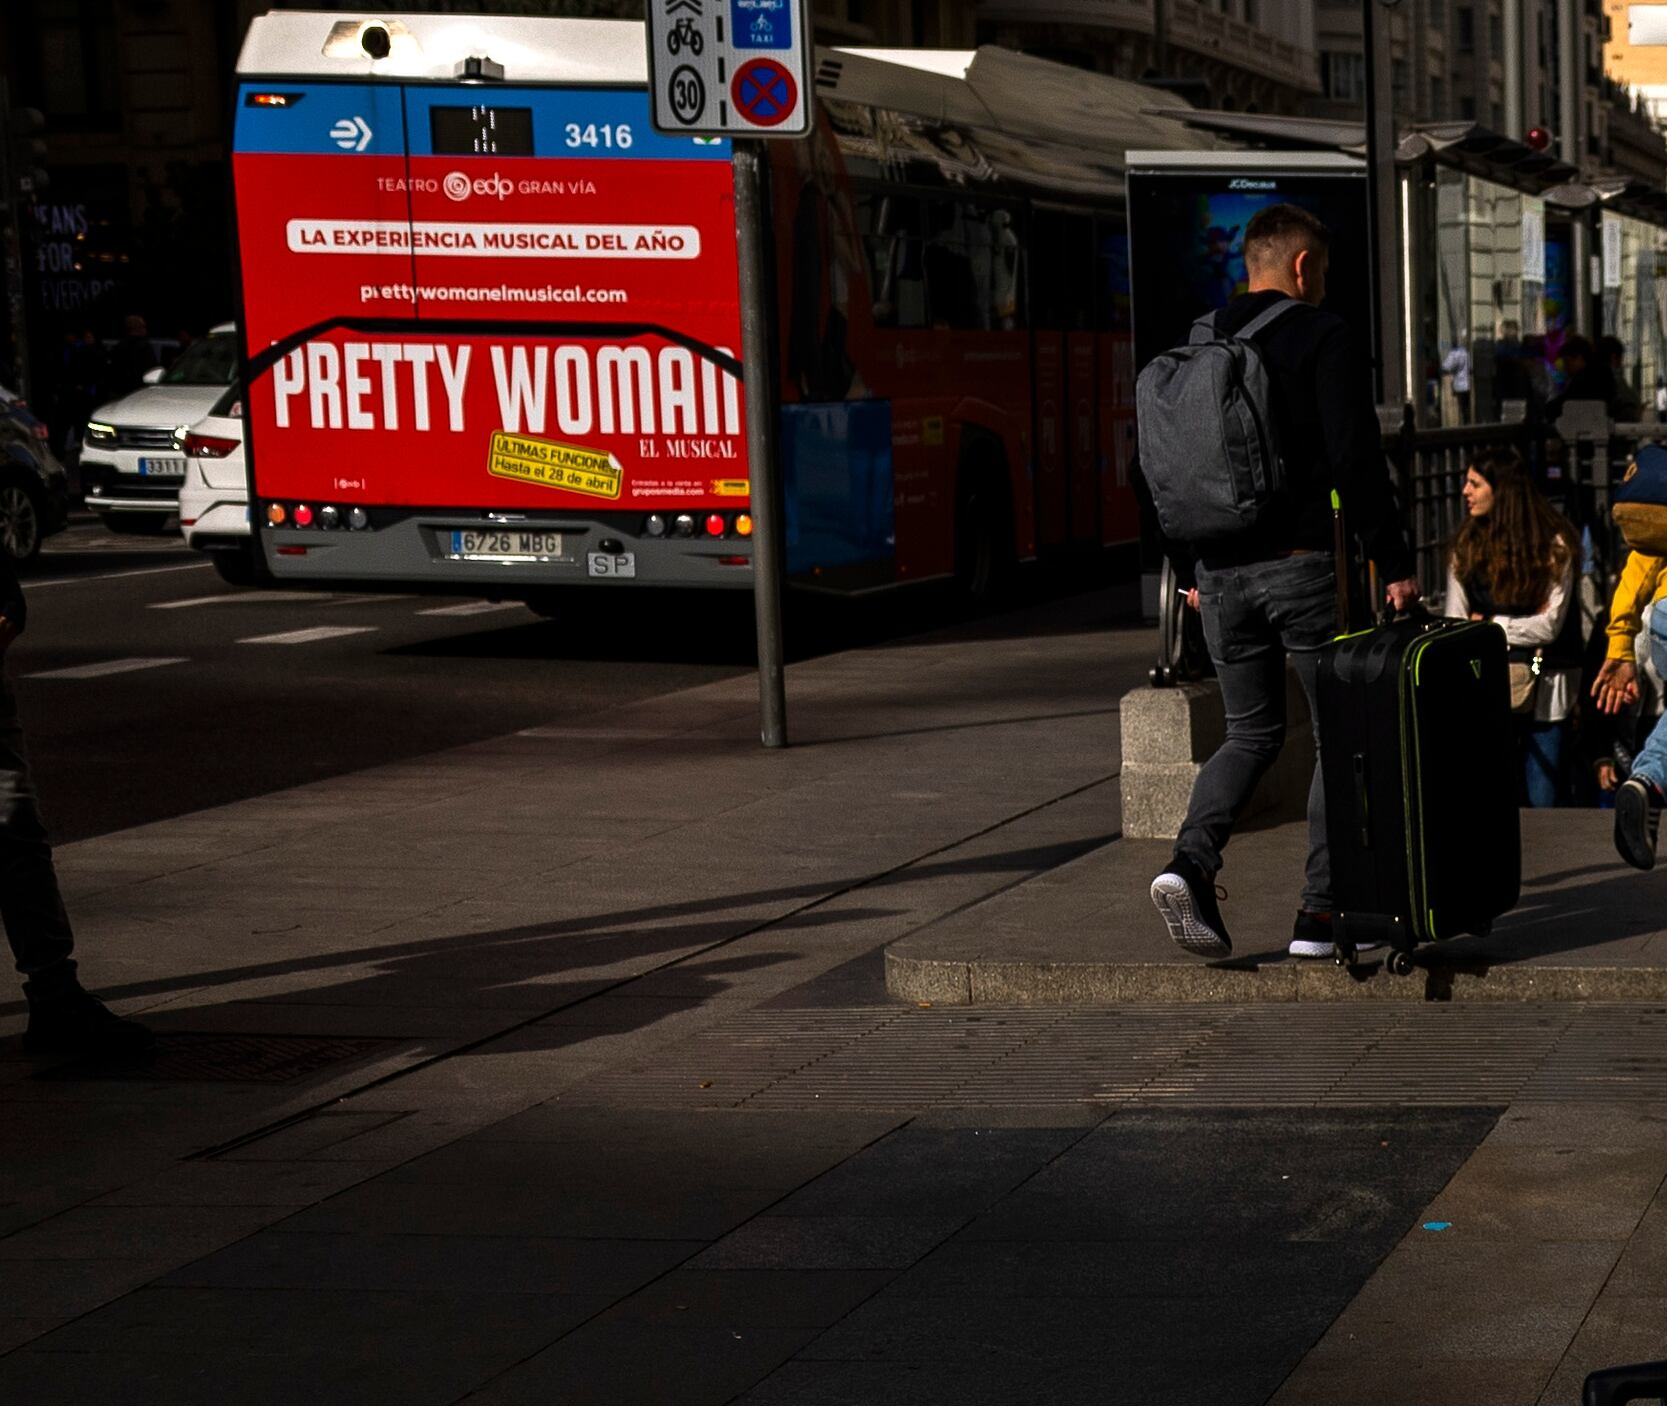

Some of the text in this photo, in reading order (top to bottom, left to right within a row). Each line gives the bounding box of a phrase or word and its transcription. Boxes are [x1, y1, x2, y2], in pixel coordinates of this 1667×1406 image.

[751, 34, 773, 43] TAXI
[676, 79, 699, 110] 30
[565, 123, 633, 149] 3416
[377, 171, 597, 201] TEATRO edp GRAN VÍA
[300, 229, 685, 251] LA EXPERIENCIA MUSICAL DEL AÑO
[360, 284, 628, 304] prettywomanelmusical.com
[270, 340, 741, 435] PRETTY WOMAN
[640, 439, 738, 459] EL MUSICAL
[495, 456, 613, 492] Hasta el 28 de abril
[463, 533, 557, 553] 6726 MBG
[594, 555, 629, 575] SP
